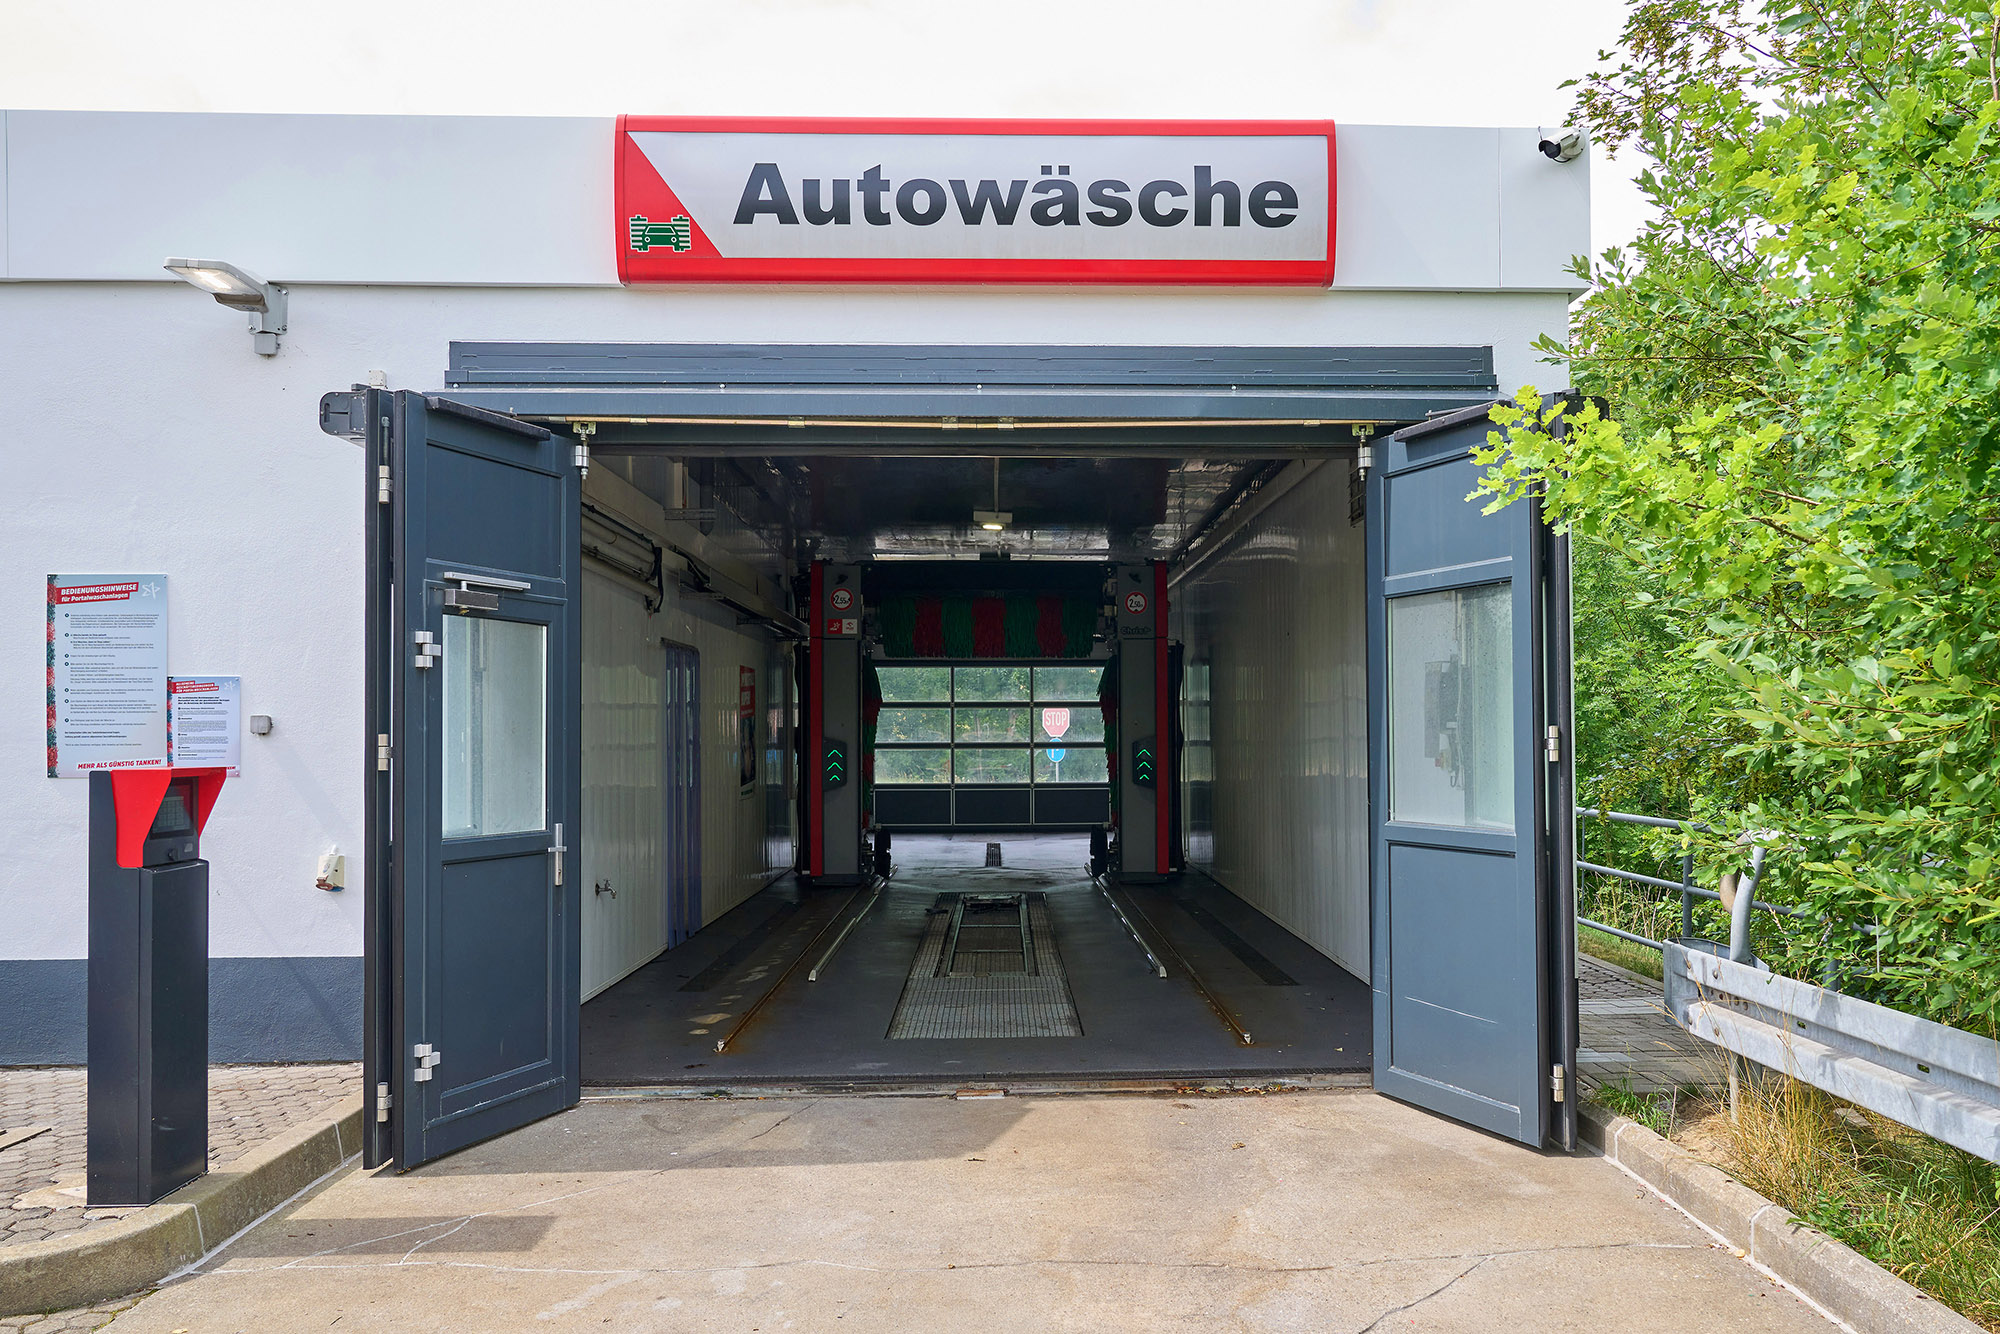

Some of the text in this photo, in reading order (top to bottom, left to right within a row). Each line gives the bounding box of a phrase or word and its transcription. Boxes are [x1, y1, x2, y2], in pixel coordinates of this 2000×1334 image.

[733, 162, 1299, 227] Autowäsche
[61, 583, 137, 595] BEDIENUNGSHINWEISE
[71, 593, 128, 602] Portalwaschanlagen
[1046, 712, 1067, 726] STOP
